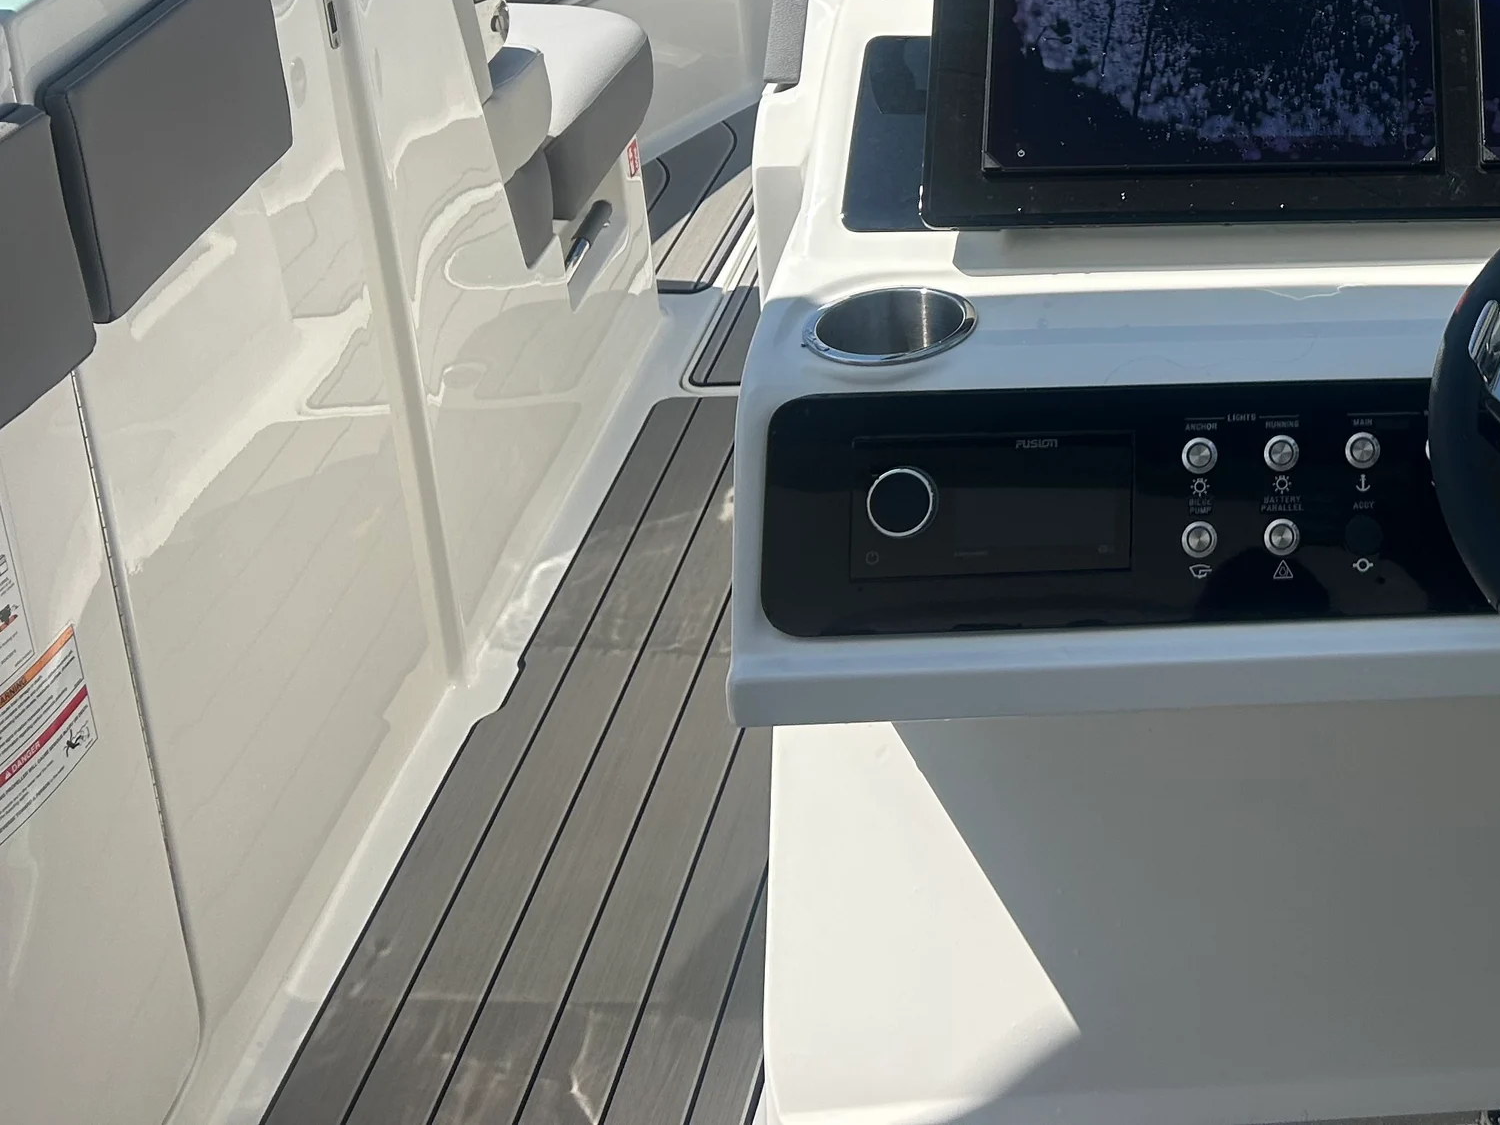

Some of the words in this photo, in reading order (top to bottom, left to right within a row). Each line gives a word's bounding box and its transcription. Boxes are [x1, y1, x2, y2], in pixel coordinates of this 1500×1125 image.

[1227, 413, 1256, 422] LIGHTS
[1185, 422, 1218, 431] ANCHOR
[1352, 419, 1373, 427] MAIN
[1263, 495, 1301, 505] BATTERY
[1189, 506, 1212, 515] PUMP
[1260, 503, 1304, 512] PARALLEL
[11, 740, 41, 774] DANGER
